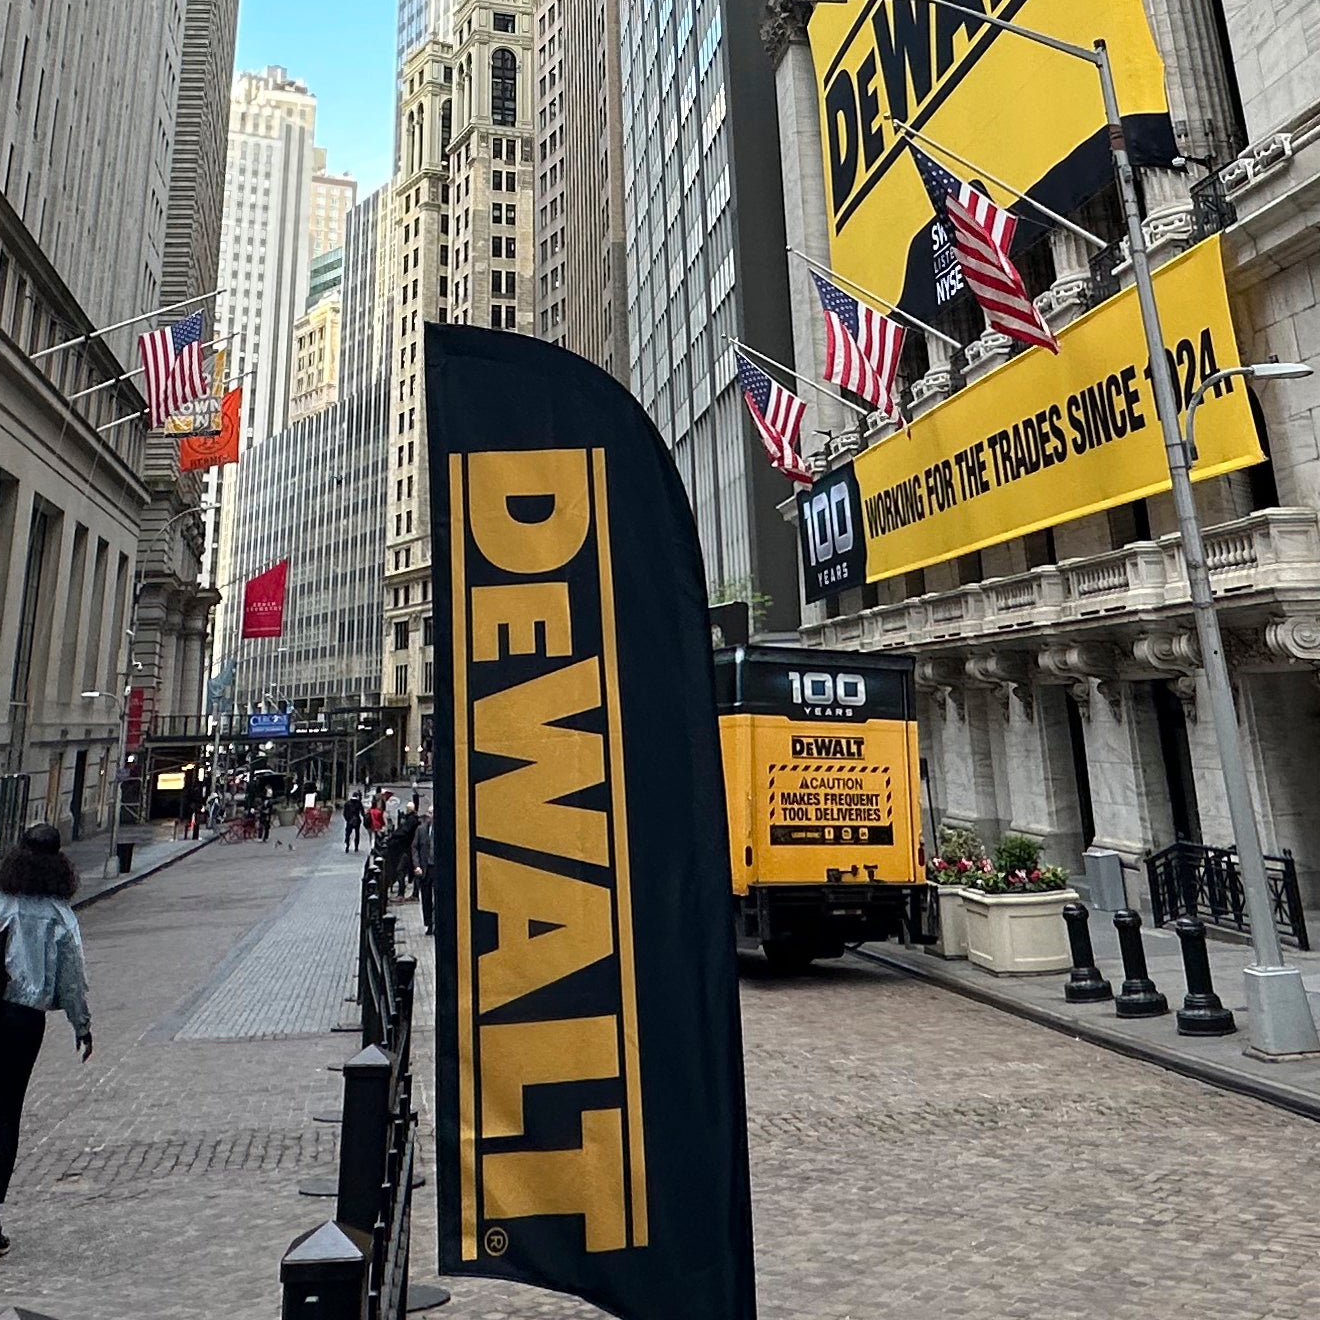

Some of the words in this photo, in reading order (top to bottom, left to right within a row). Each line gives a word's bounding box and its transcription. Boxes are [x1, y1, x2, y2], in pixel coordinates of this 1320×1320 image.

[933, 246, 955, 274] LISTE
[935, 265, 965, 305] NYSE
[864, 479, 925, 540] WORKING
[925, 459, 958, 516] FOR
[955, 442, 991, 499] THE
[987, 404, 1068, 487] TRADES
[1067, 365, 1146, 455] SINCE
[803, 481, 854, 567] 100
[817, 562, 849, 588] YEARS
[788, 671, 867, 706] 100
[804, 707, 854, 717] YEARS
[791, 738, 865, 758] DEWALT
[809, 777, 863, 790] CAUTION
[780, 792, 821, 806] MAKES
[824, 793, 881, 807] FREQUENT
[783, 808, 811, 821] TOOL
[815, 808, 881, 822] DELIVERIES
[468, 448, 627, 1253] DEWALT
